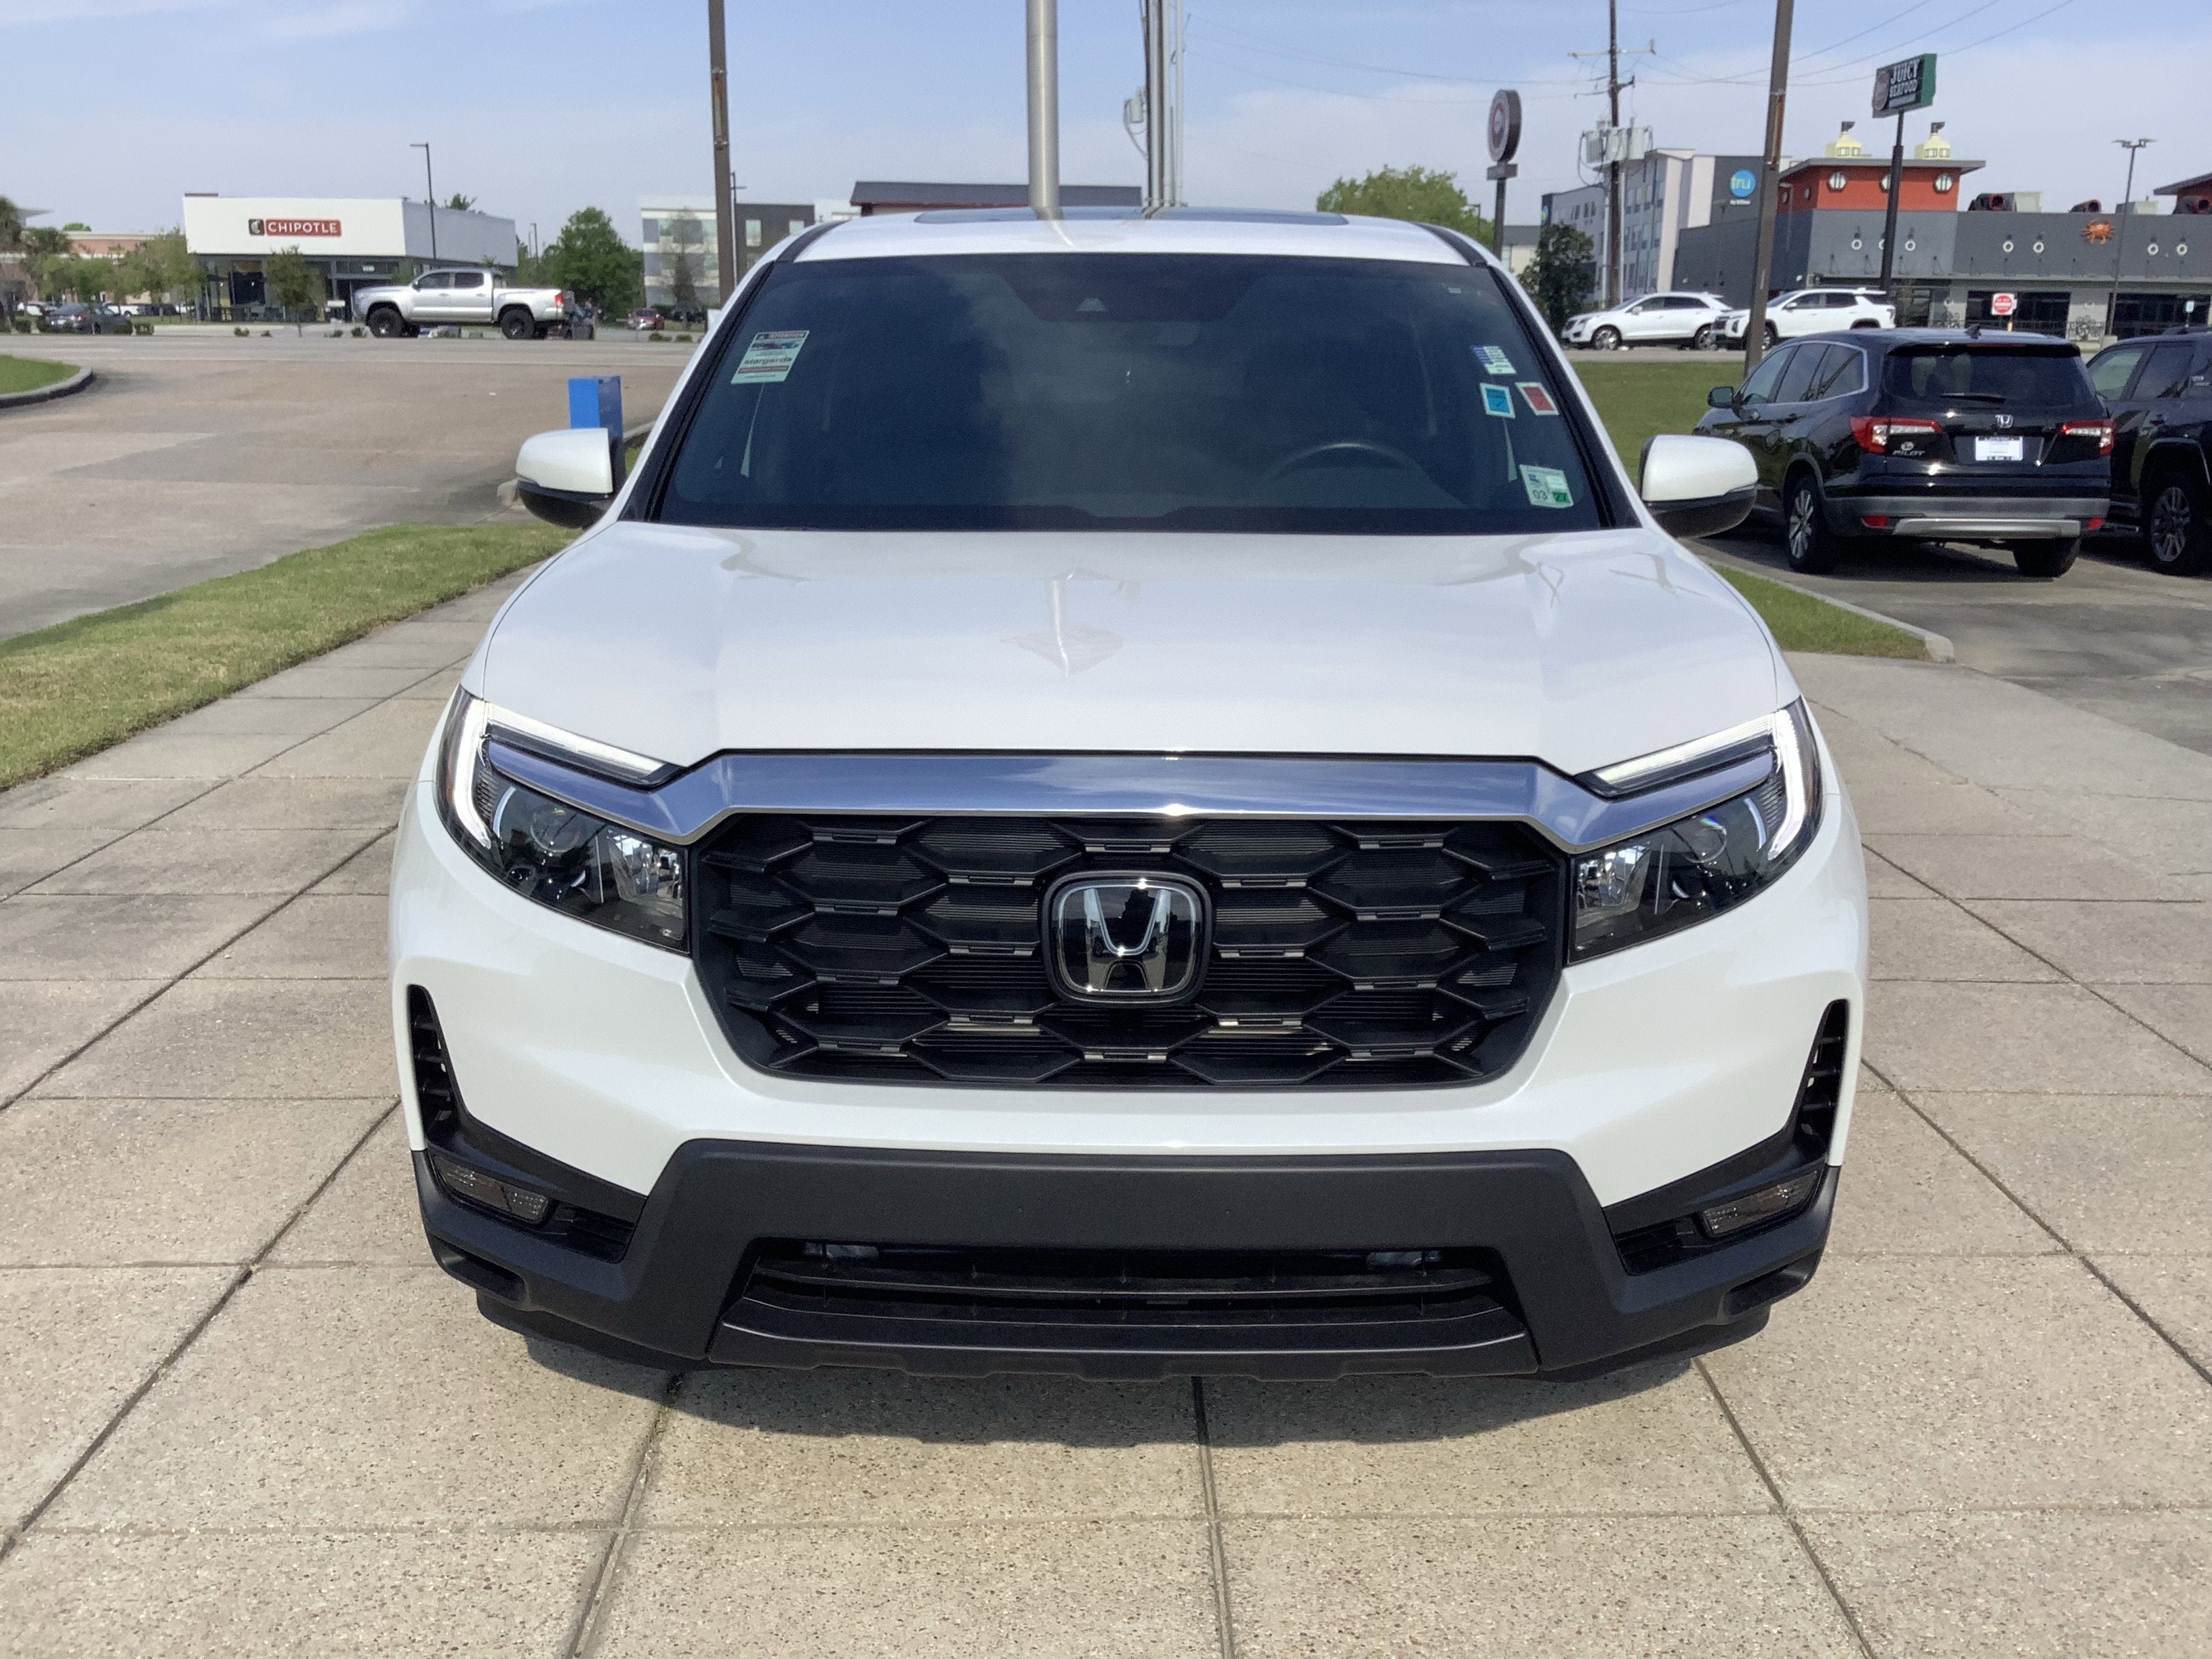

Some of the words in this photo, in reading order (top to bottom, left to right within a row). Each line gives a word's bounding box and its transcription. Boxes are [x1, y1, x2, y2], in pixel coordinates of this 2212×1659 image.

[1890, 58, 1921, 85] JUICY
[1730, 174, 1751, 189] tru
[268, 221, 337, 234] CHIPOTLE
[1532, 489, 1548, 500] 03
